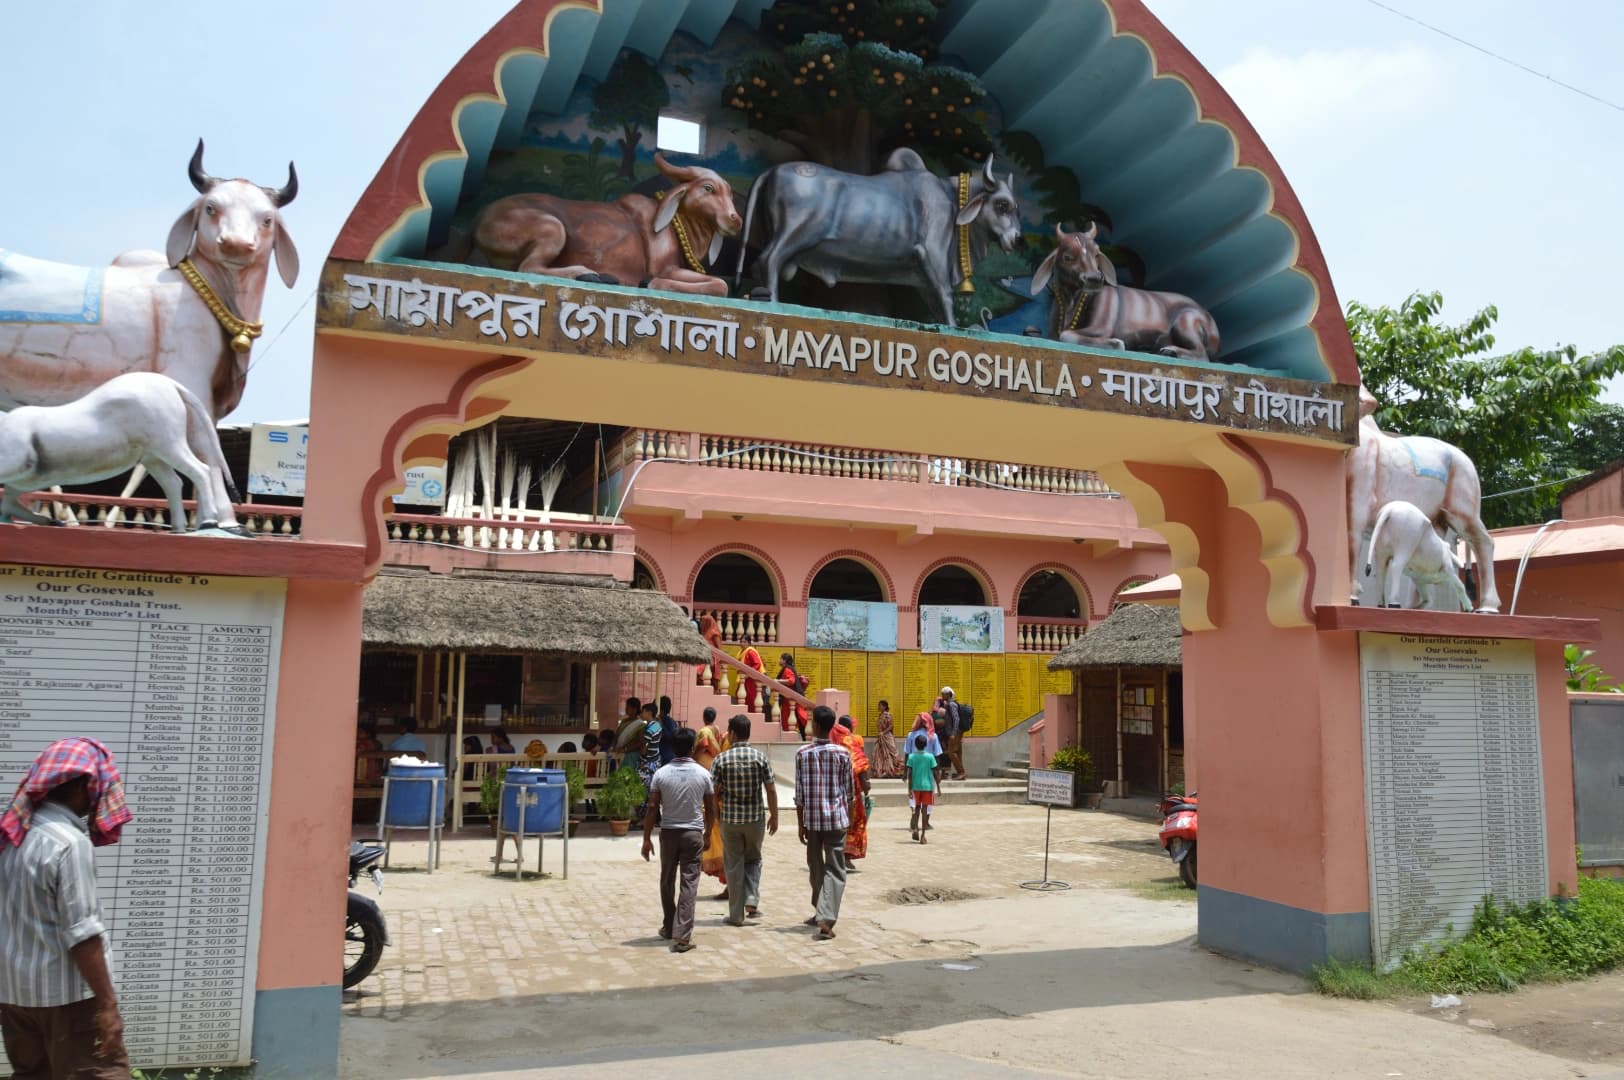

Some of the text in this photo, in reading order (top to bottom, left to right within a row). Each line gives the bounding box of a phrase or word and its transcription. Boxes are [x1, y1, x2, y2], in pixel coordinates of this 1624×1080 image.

[344, 274, 740, 360] মায়াপুর গোশালা
[764, 326, 1078, 398] MAYAPUR GOSHALA
[1098, 368, 1344, 431] मायापुर गोशाला
[278, 461, 305, 470] Resea
[0, 566, 209, 586] ur Heartfelt Gratitude To
[36, 582, 154, 597] Our Gosevaks
[5, 594, 182, 610] Sri Mayapur Goshala Trust.
[26, 606, 160, 620] Monthly Donor's List
[150, 623, 189, 631] PLACE
[211, 625, 262, 634] AMOUNT
[148, 673, 186, 681] Kolkata
[151, 693, 179, 701] Delhi
[143, 723, 181, 731] Kolkata
[142, 733, 180, 741] Kolkata
[130, 888, 166, 896] Kolkata
[128, 909, 165, 917] Kolkata
[125, 929, 164, 937] Kolkata
[123, 950, 162, 958] Kolkata
[122, 961, 161, 969] Kolkata
[121, 971, 160, 980] Kolkata
[120, 982, 159, 990] Kolkata
